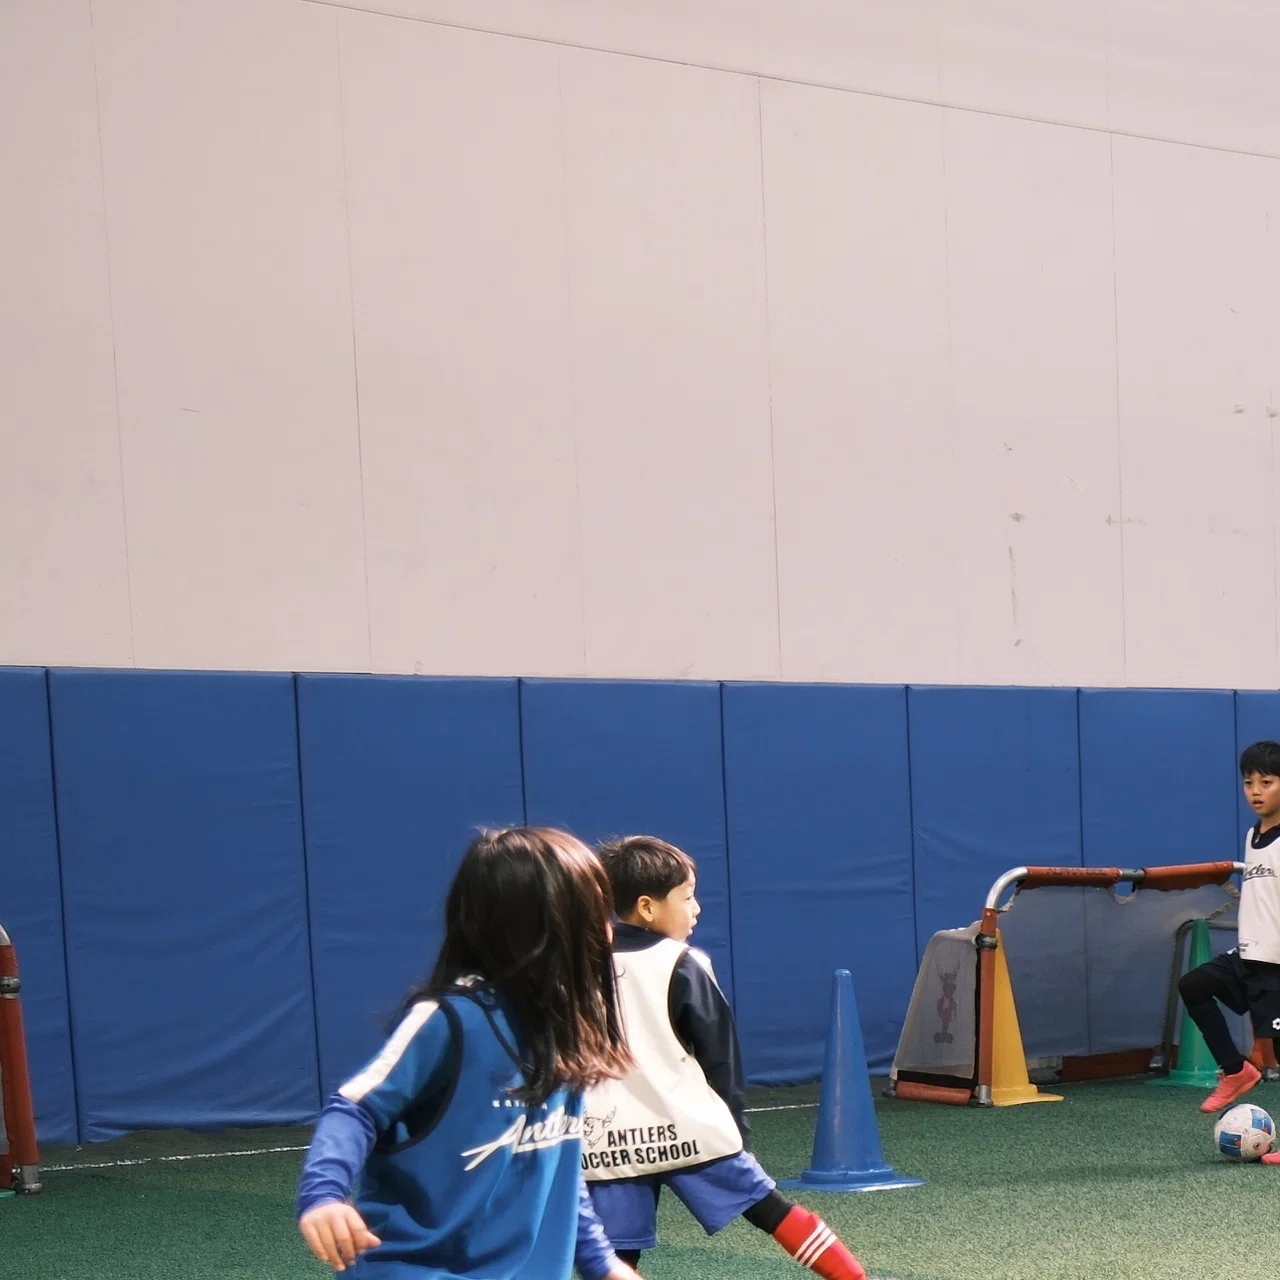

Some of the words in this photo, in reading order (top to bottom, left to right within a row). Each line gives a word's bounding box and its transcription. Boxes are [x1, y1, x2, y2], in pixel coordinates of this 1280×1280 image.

[461, 1105, 583, 1172] Antler
[607, 1124, 678, 1148] ANTLERS
[581, 1150, 632, 1171] OCCER
[635, 1139, 701, 1165] SCHOOL
